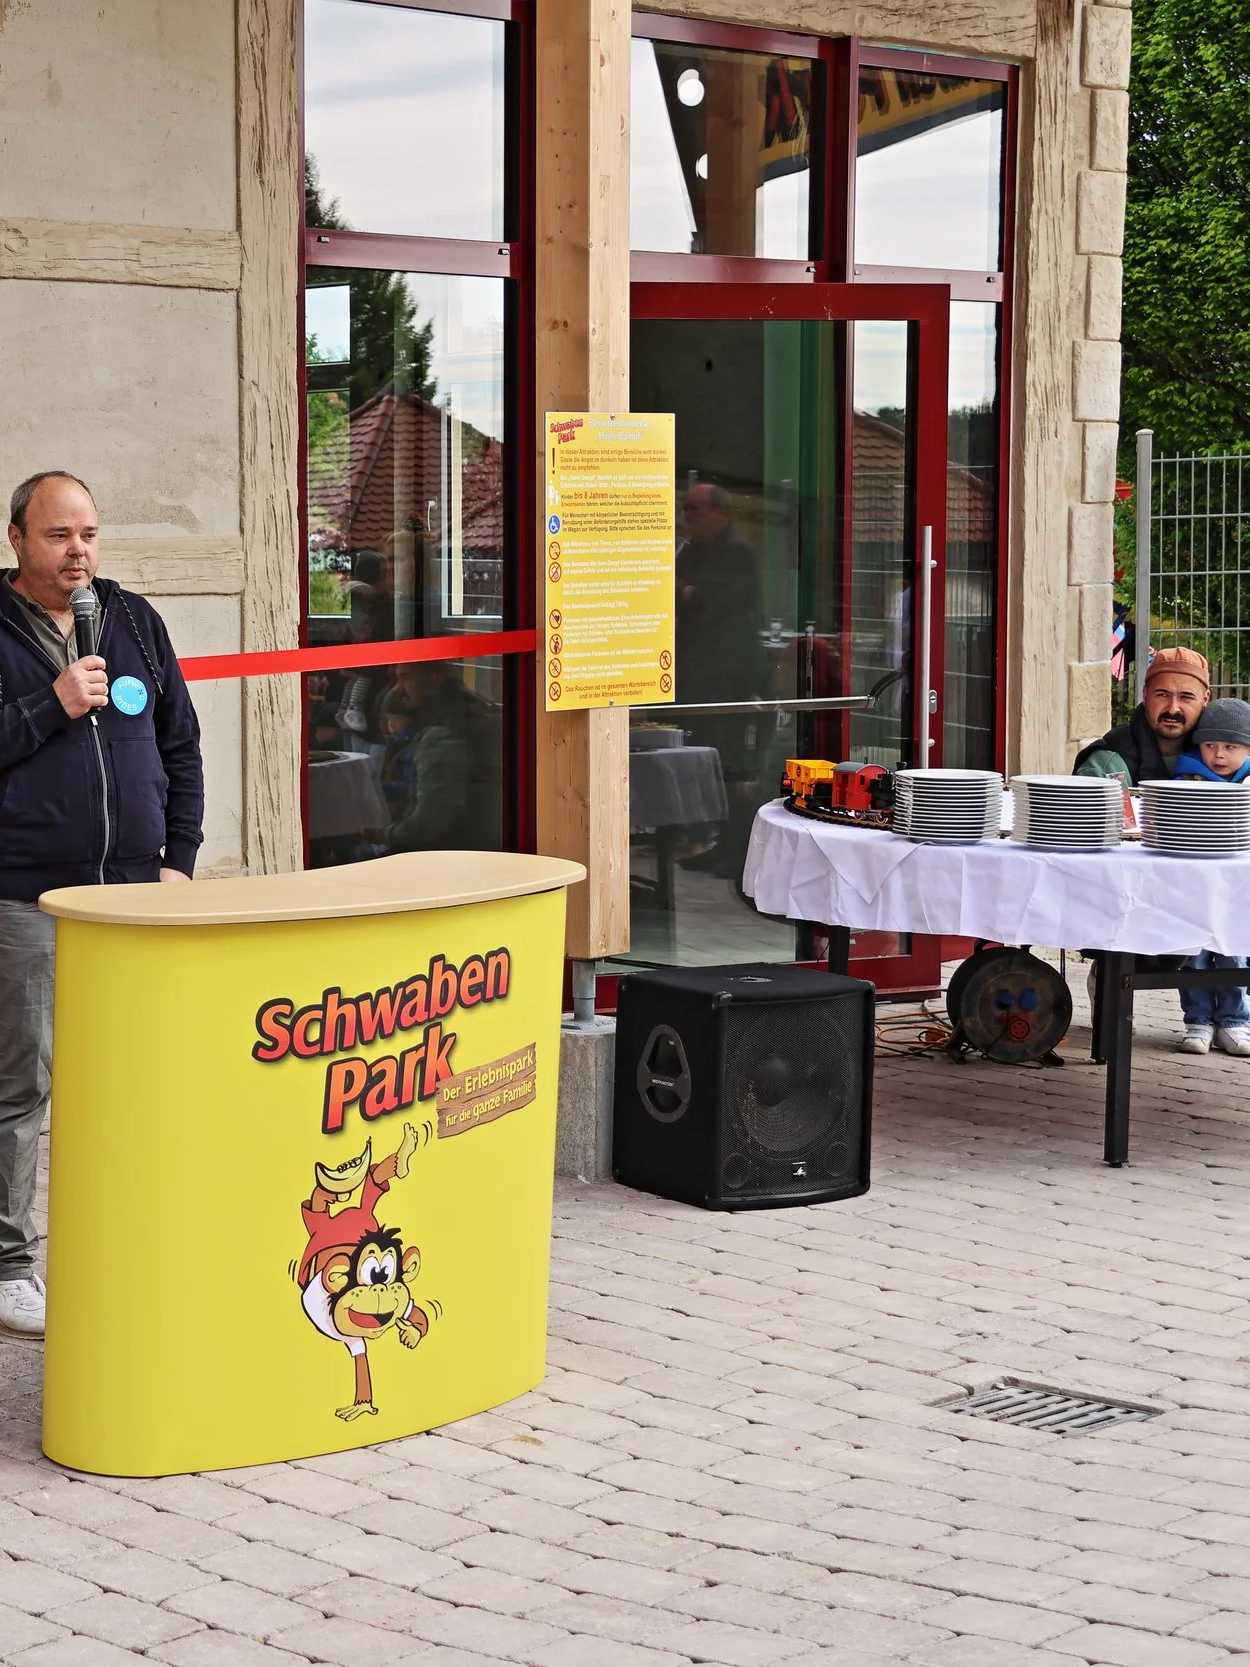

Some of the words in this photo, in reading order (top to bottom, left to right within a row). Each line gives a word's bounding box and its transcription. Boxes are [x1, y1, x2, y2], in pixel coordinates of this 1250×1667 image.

[550, 418, 584, 433] Schwaben
[557, 429, 576, 444] Park
[115, 695, 138, 711] RIDES
[251, 947, 510, 1063] Schwaben
[321, 1021, 457, 1135] Park
[443, 1084, 461, 1102] Der
[464, 1049, 534, 1094] Erlebnispark
[445, 1113, 457, 1127] für
[459, 1109, 471, 1122] die
[473, 1095, 501, 1120] ganze
[503, 1079, 533, 1104] Familie
